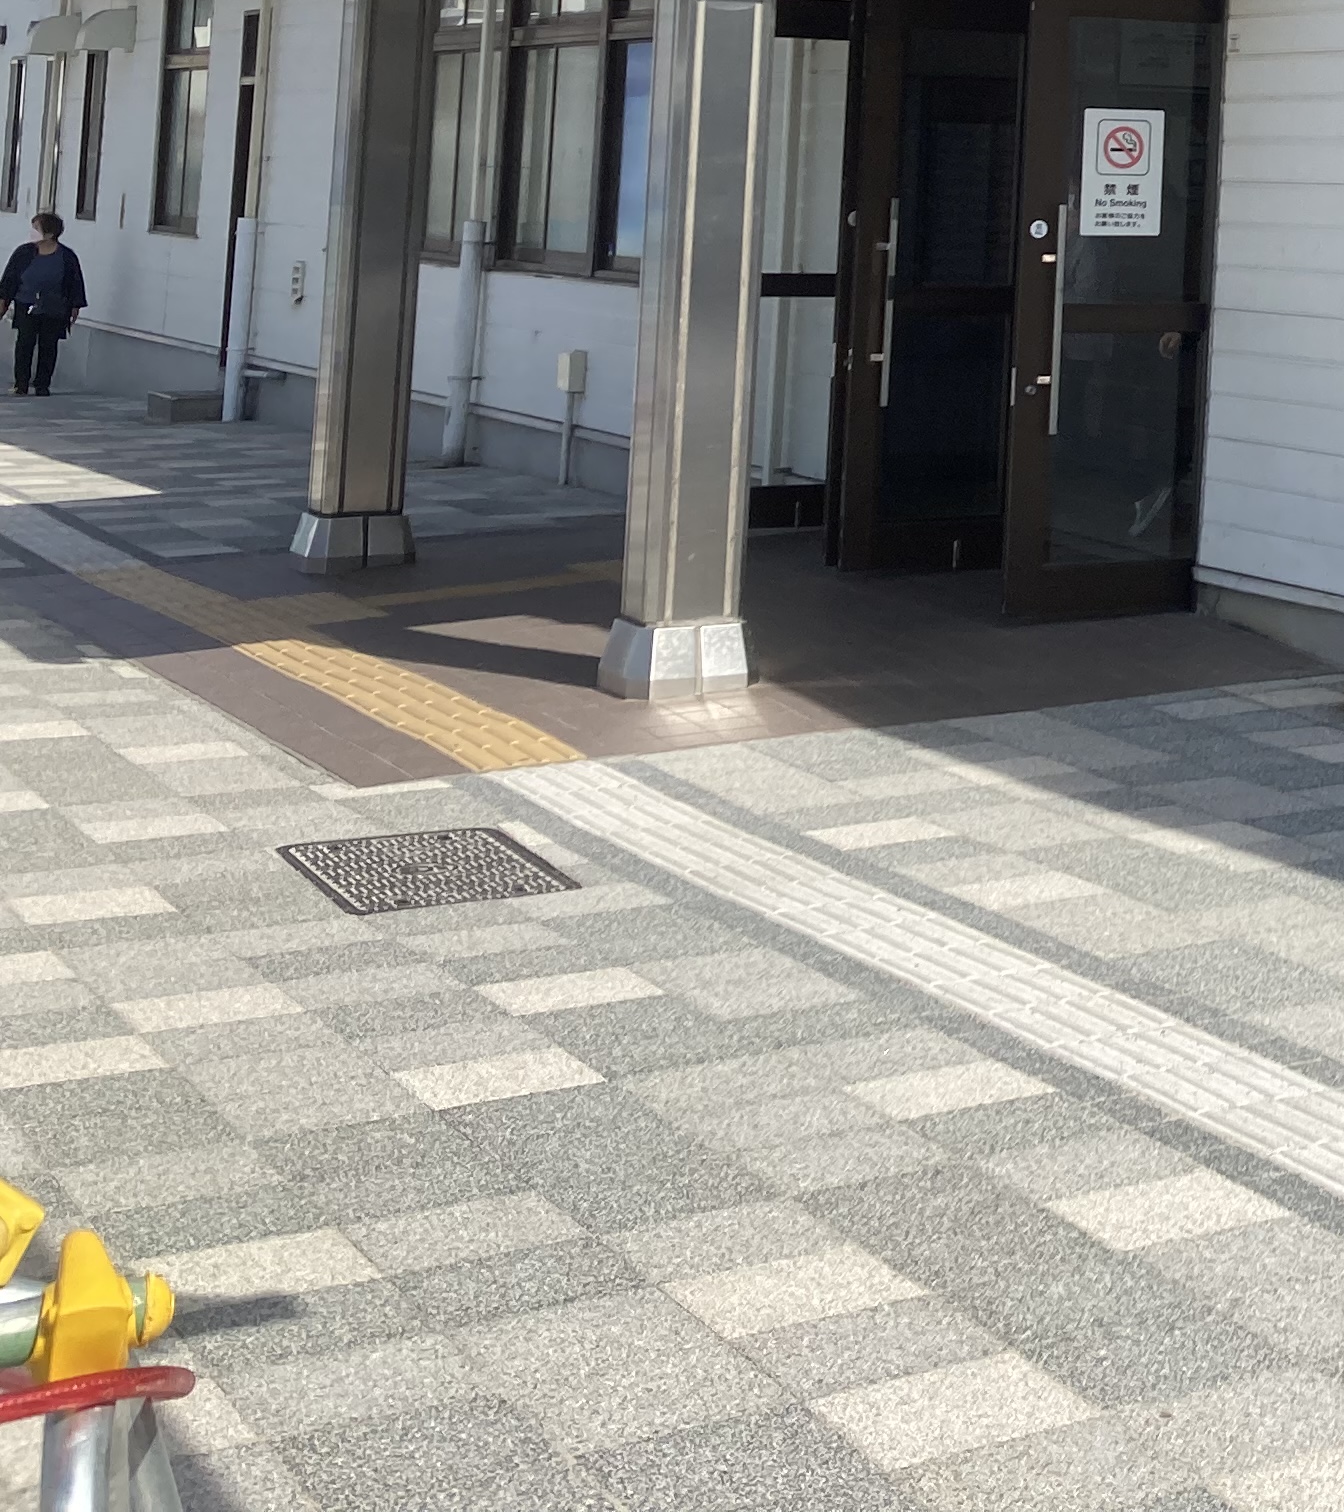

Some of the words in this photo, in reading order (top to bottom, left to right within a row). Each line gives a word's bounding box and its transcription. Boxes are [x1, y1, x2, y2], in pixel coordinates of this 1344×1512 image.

[1104, 183, 1140, 195] 禁煙
[1094, 199, 1108, 207] No
[1109, 198, 1147, 208] Smoking
